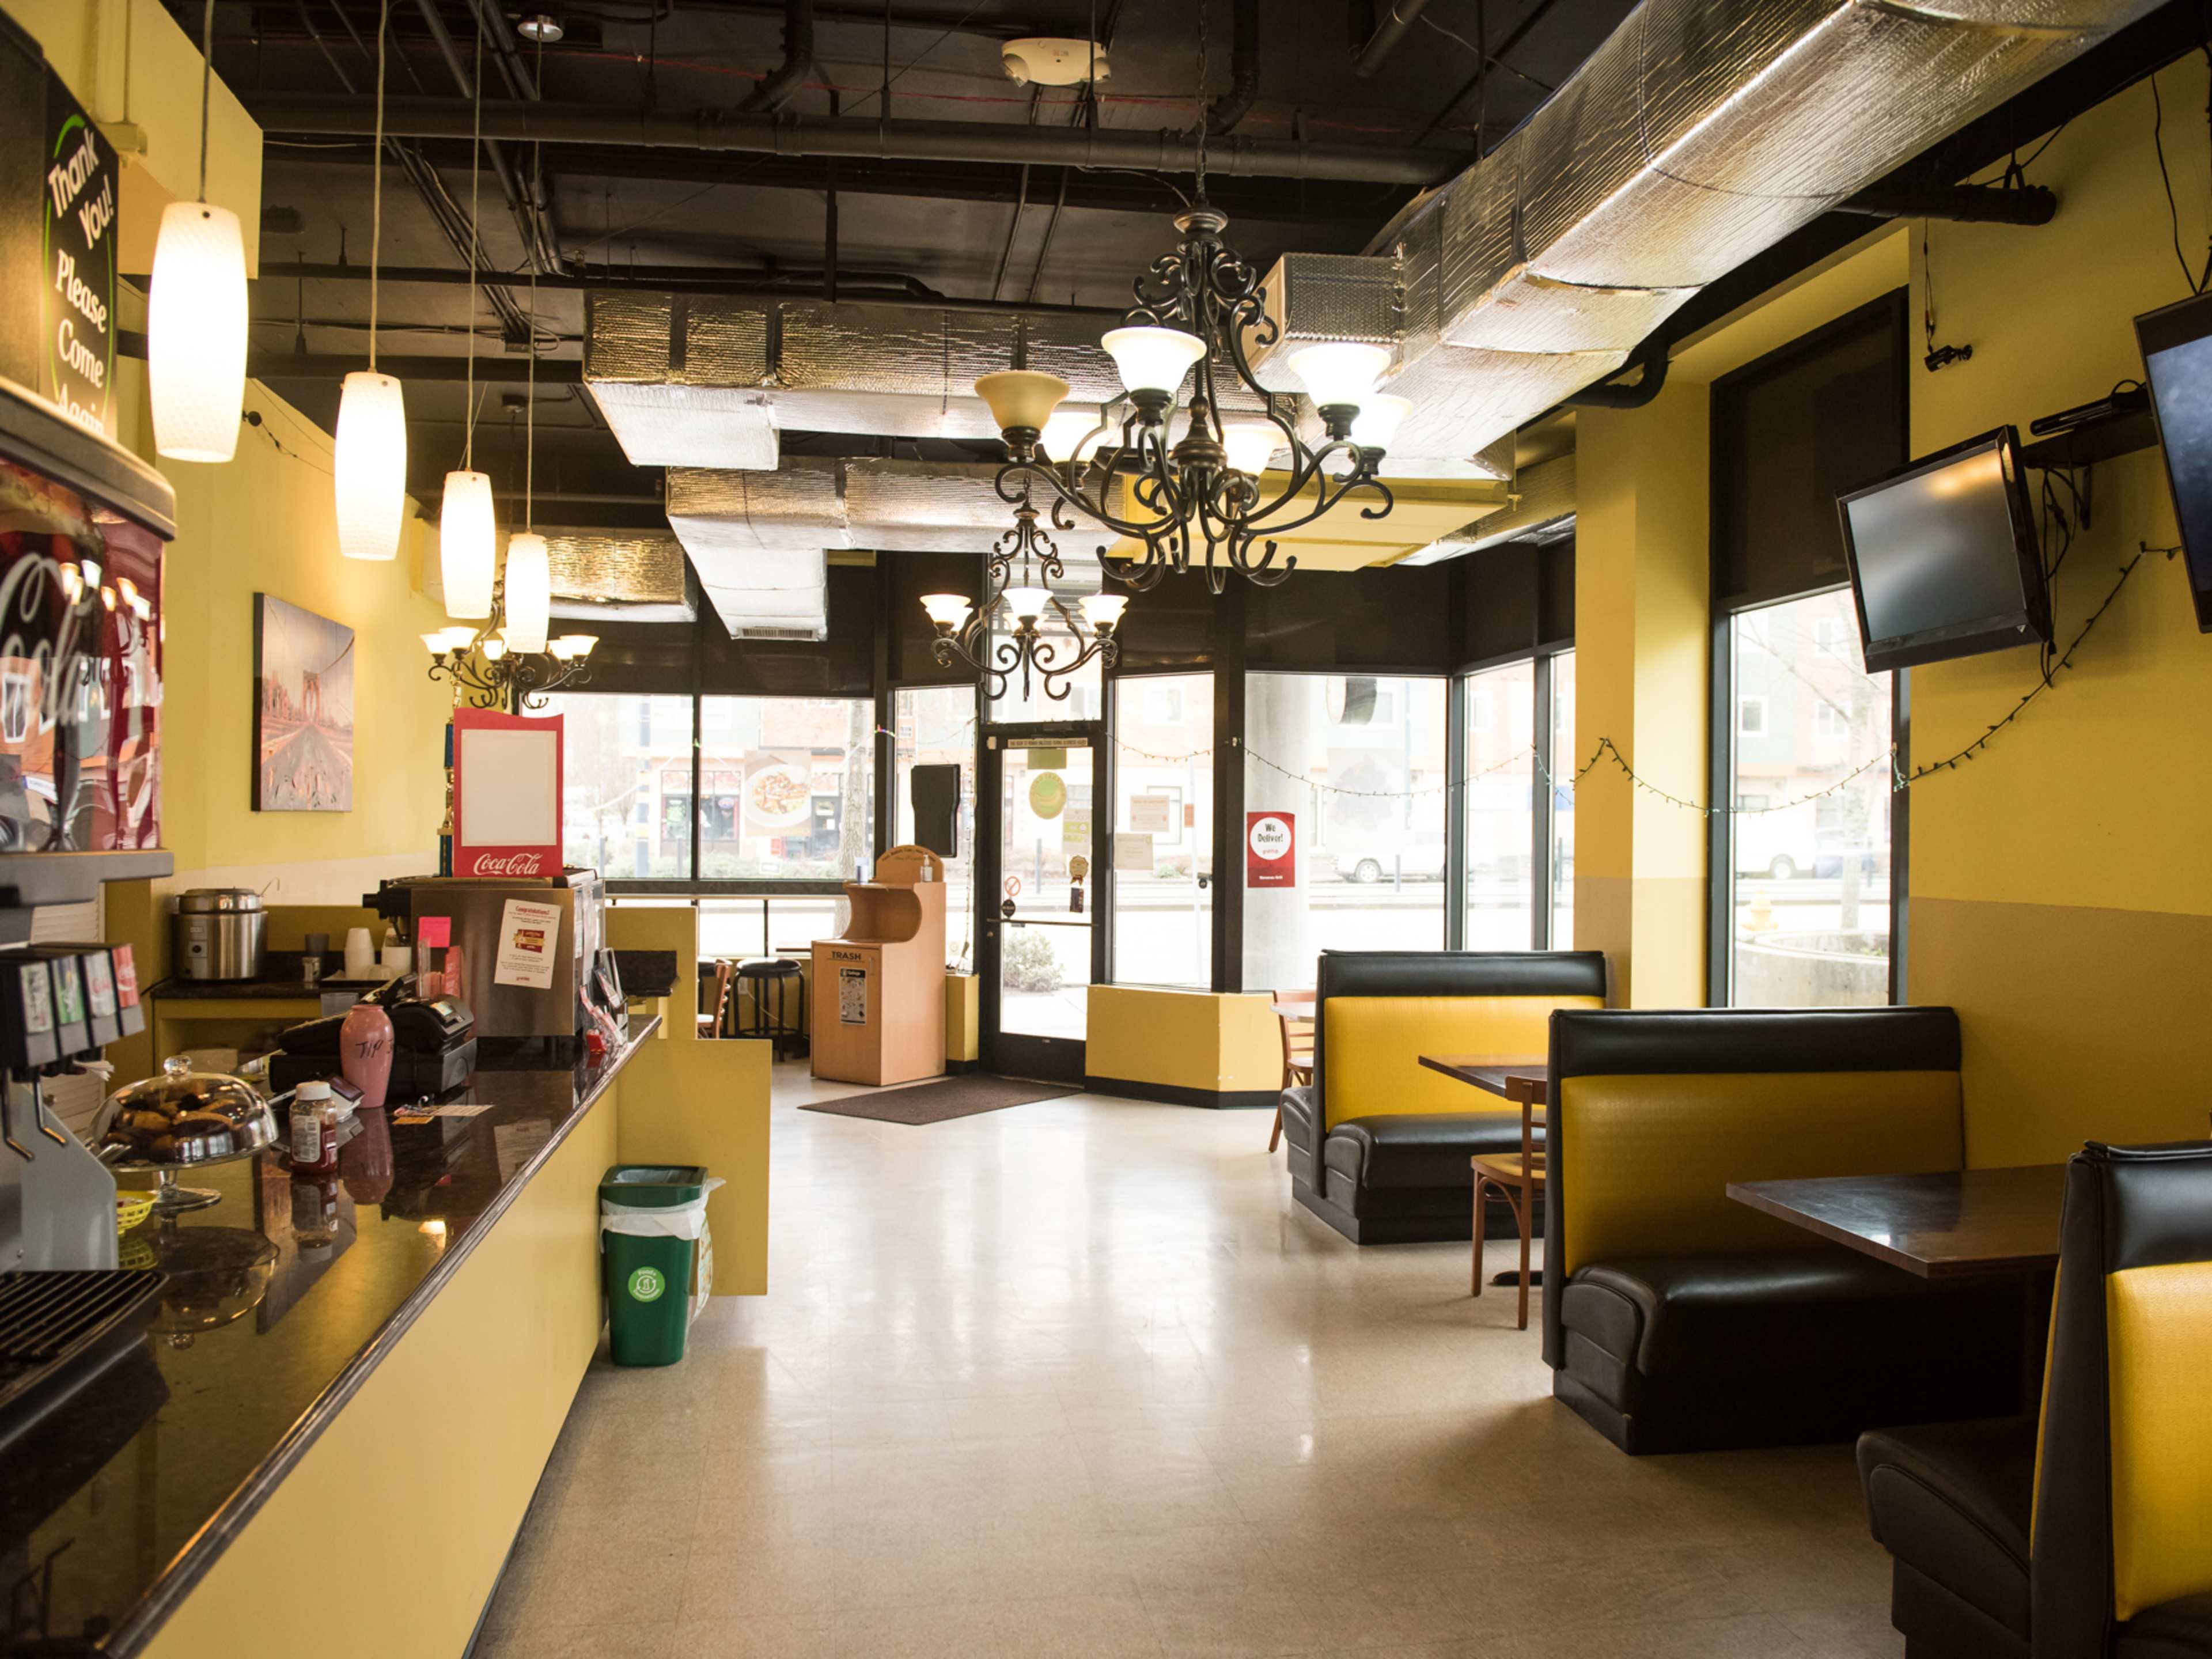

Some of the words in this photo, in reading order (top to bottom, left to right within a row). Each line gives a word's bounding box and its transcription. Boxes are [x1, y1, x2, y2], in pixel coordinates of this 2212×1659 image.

[48, 127, 100, 219] Thank
[78, 174, 114, 250] You!
[55, 248, 108, 334] Please
[58, 317, 104, 388] Come
[1257, 833, 1283, 843] Deliver!
[1265, 824, 1276, 832] We
[473, 853, 543, 876] Coca-Cola
[831, 951, 862, 960] TRASH
[355, 1039, 384, 1059] TIP
